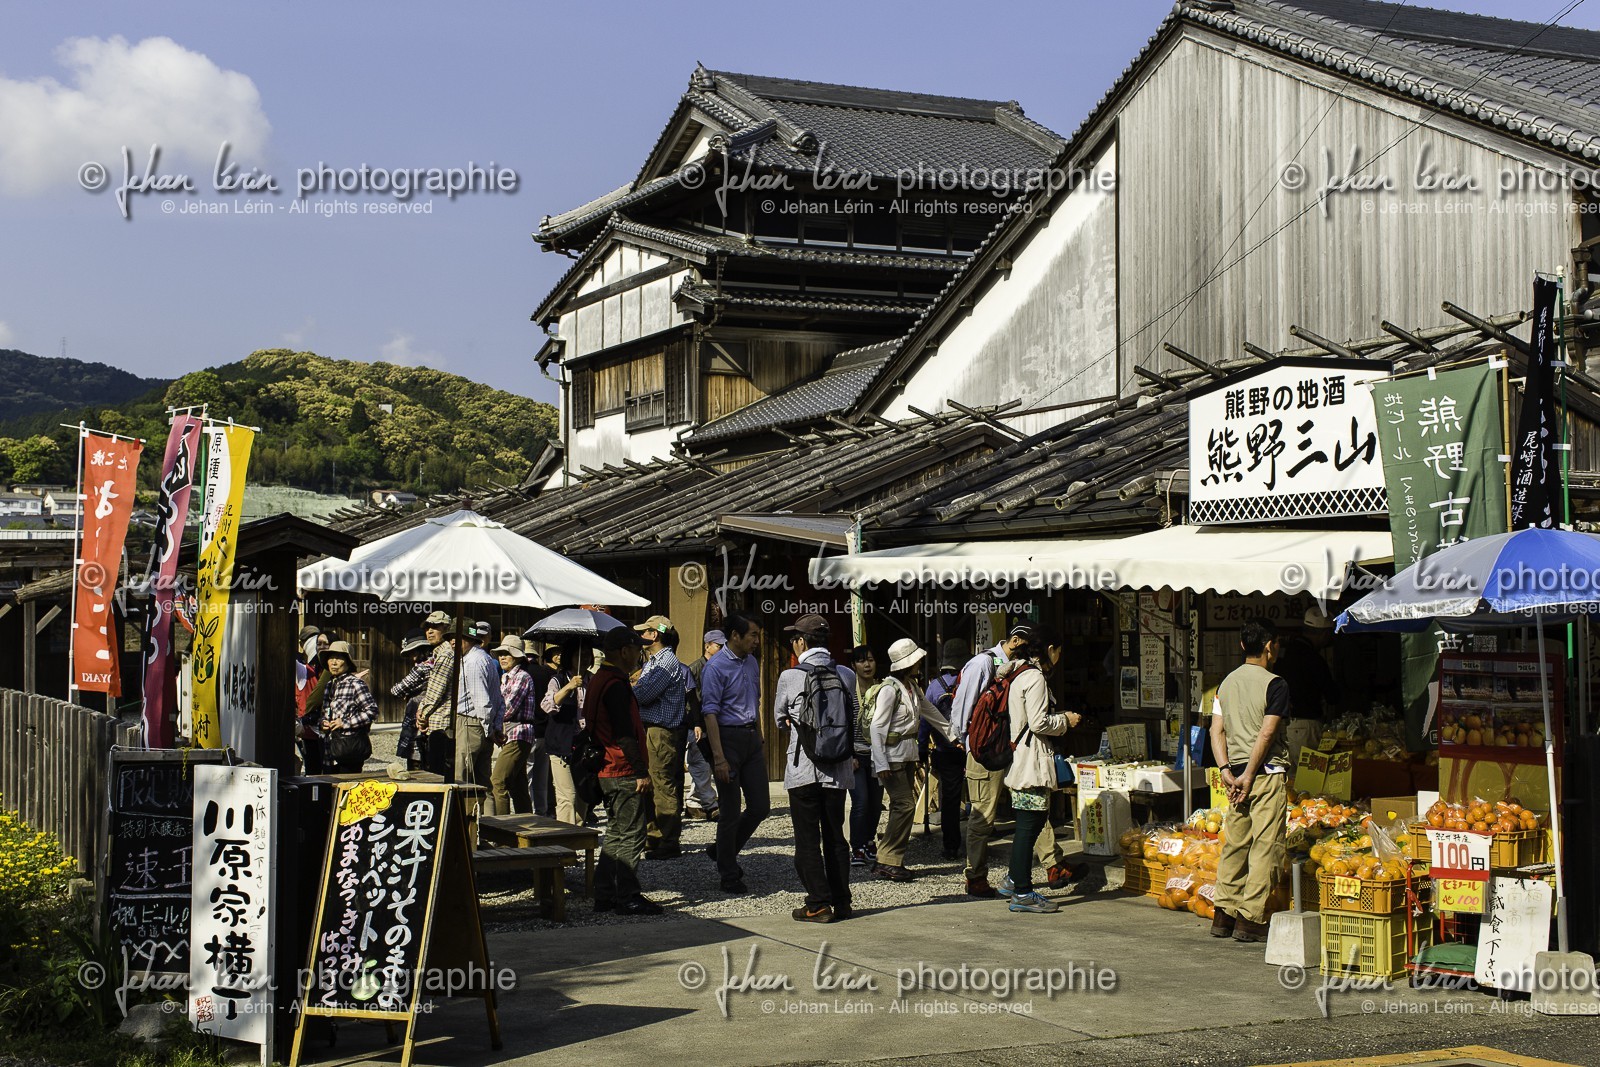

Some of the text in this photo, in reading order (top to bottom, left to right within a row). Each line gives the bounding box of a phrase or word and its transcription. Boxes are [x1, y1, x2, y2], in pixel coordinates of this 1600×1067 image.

[1225, 375, 1346, 420] 熊野の地酒
[1200, 415, 1377, 491] 熊野三山
[1511, 430, 1539, 524] 尾崎酒造株
[360, 814, 395, 951] シャーベット
[1438, 842, 1485, 871] 100円
[1457, 895, 1480, 906] 100
